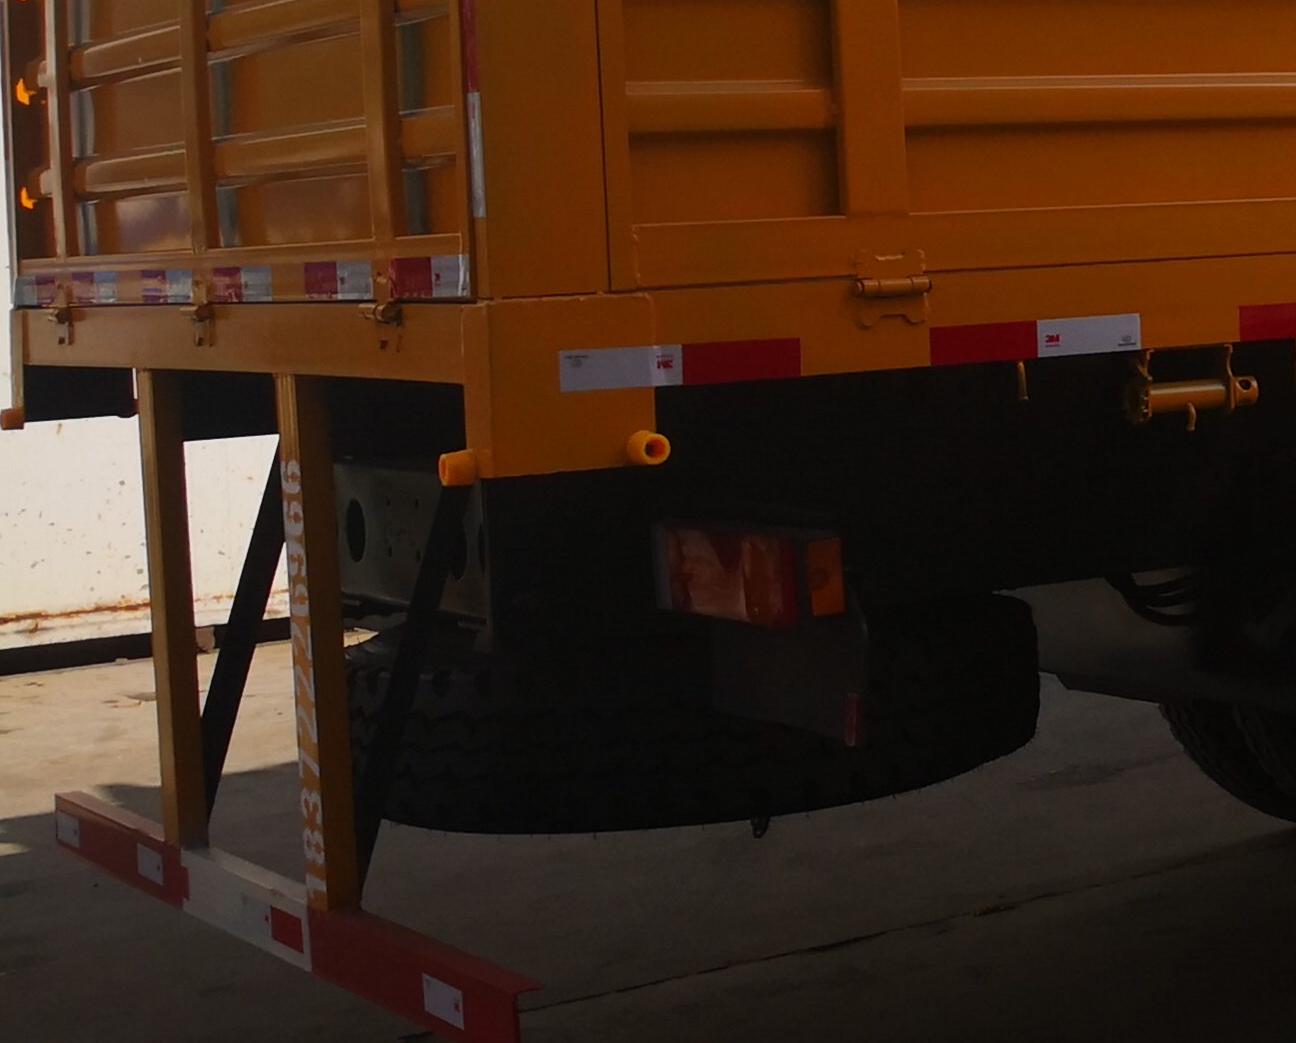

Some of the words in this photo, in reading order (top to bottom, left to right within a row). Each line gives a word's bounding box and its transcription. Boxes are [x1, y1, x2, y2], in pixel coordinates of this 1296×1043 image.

[1045, 334, 1060, 343] 3M
[657, 359, 673, 369] 3M
[279, 459, 328, 900] 18372226966
